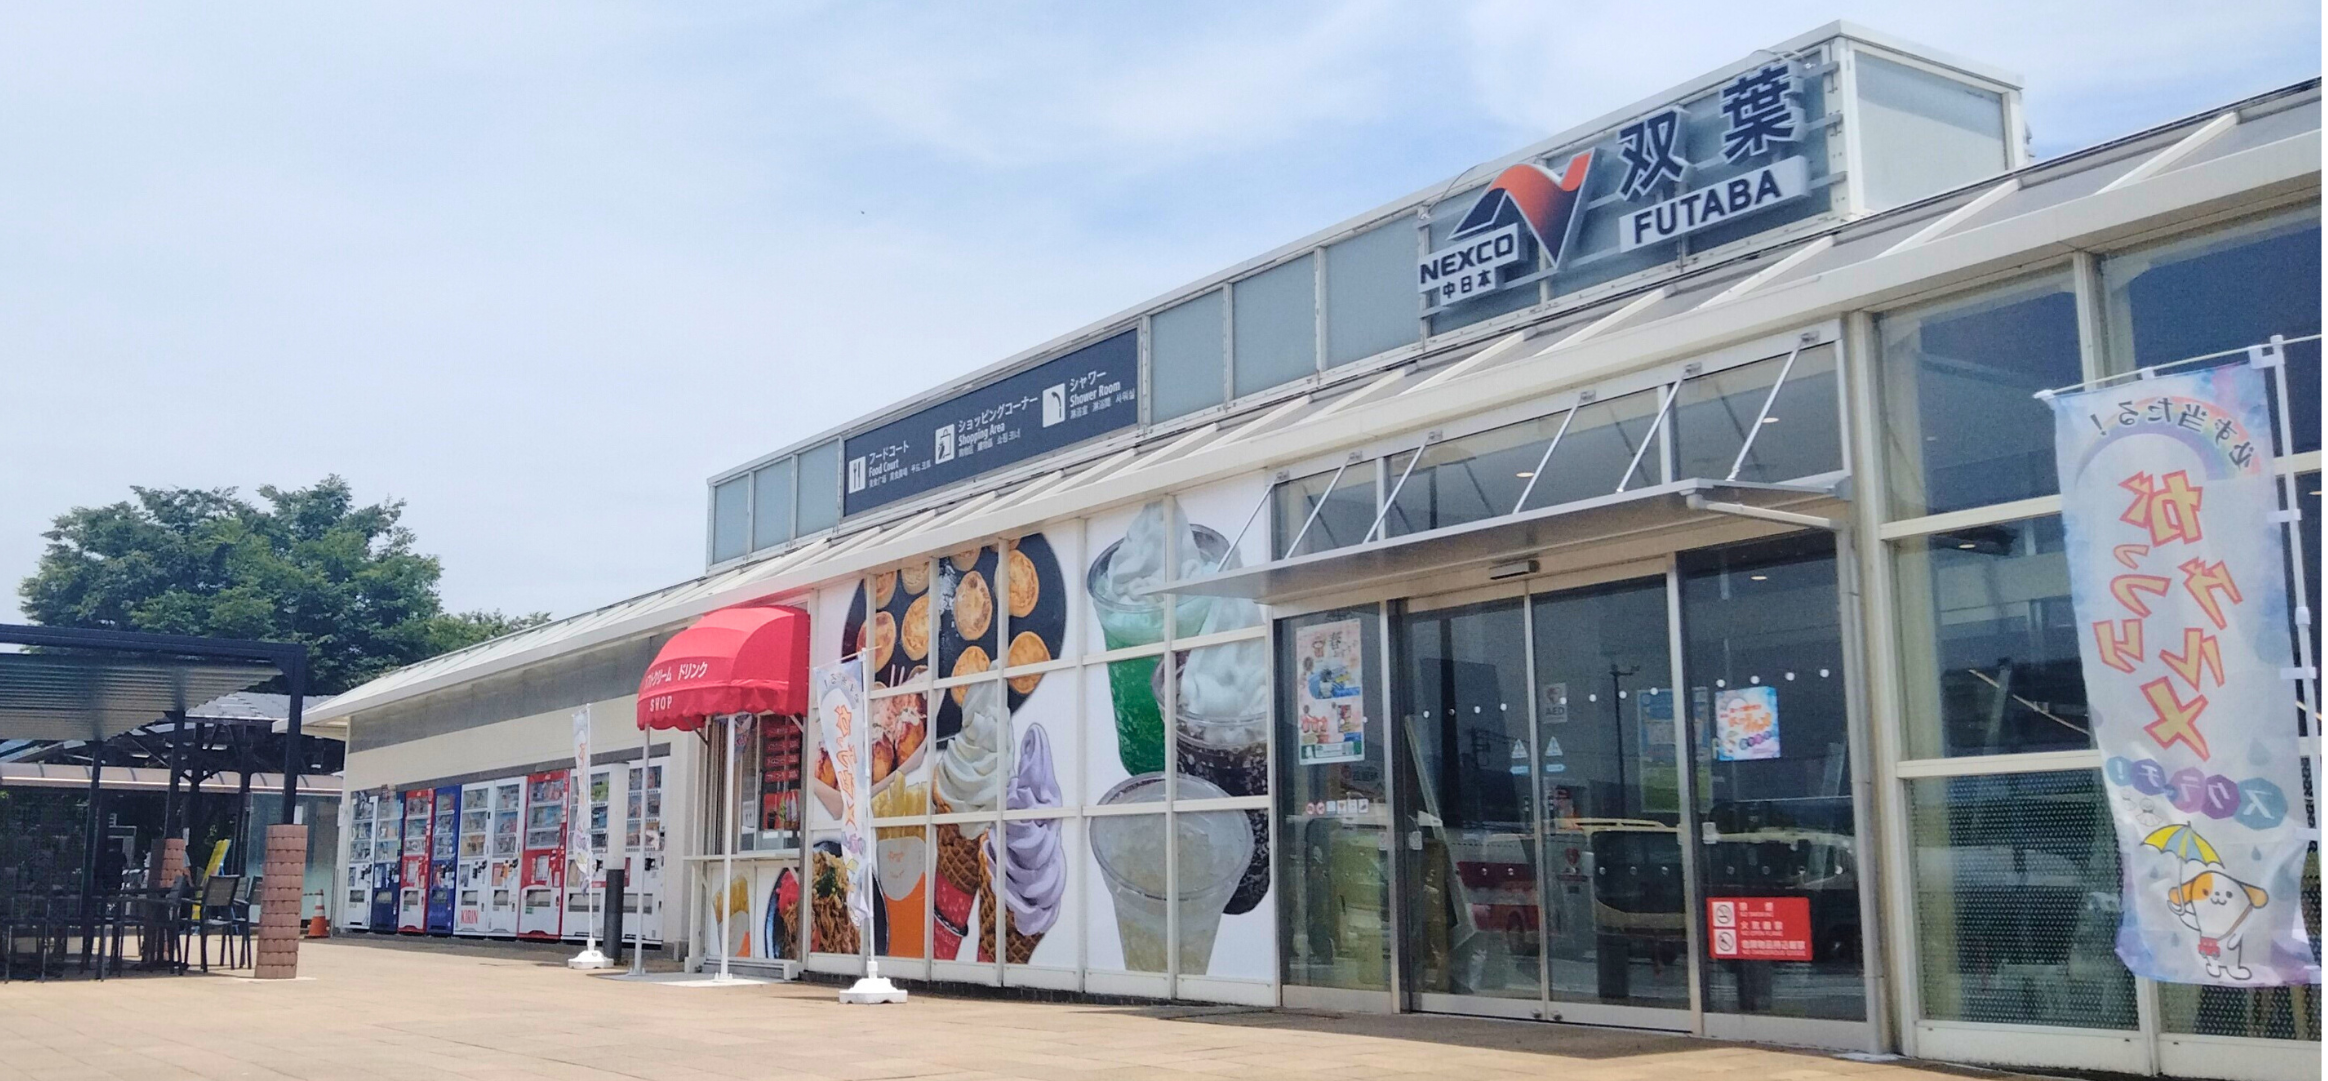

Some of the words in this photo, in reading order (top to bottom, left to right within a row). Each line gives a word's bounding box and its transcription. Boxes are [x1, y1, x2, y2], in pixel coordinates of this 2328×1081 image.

[1616, 64, 1797, 200] 双葉
[1634, 169, 1782, 245] FUTABA
[1420, 232, 1514, 285] NEXCO
[1442, 269, 1492, 299] 中日本
[1069, 370, 1107, 392] シャワー
[1069, 389, 1097, 408] Shower
[1098, 381, 1121, 397] Room
[957, 395, 1039, 434] ショッピングコーナー
[958, 427, 988, 447] Shopping
[989, 422, 1006, 436] Area
[868, 439, 910, 465] フードコート
[868, 463, 883, 478] Food
[883, 458, 900, 473] Court
[677, 661, 709, 681] ドリンク
[649, 695, 673, 713] SHOP
[461, 911, 478, 924] KIRIN
